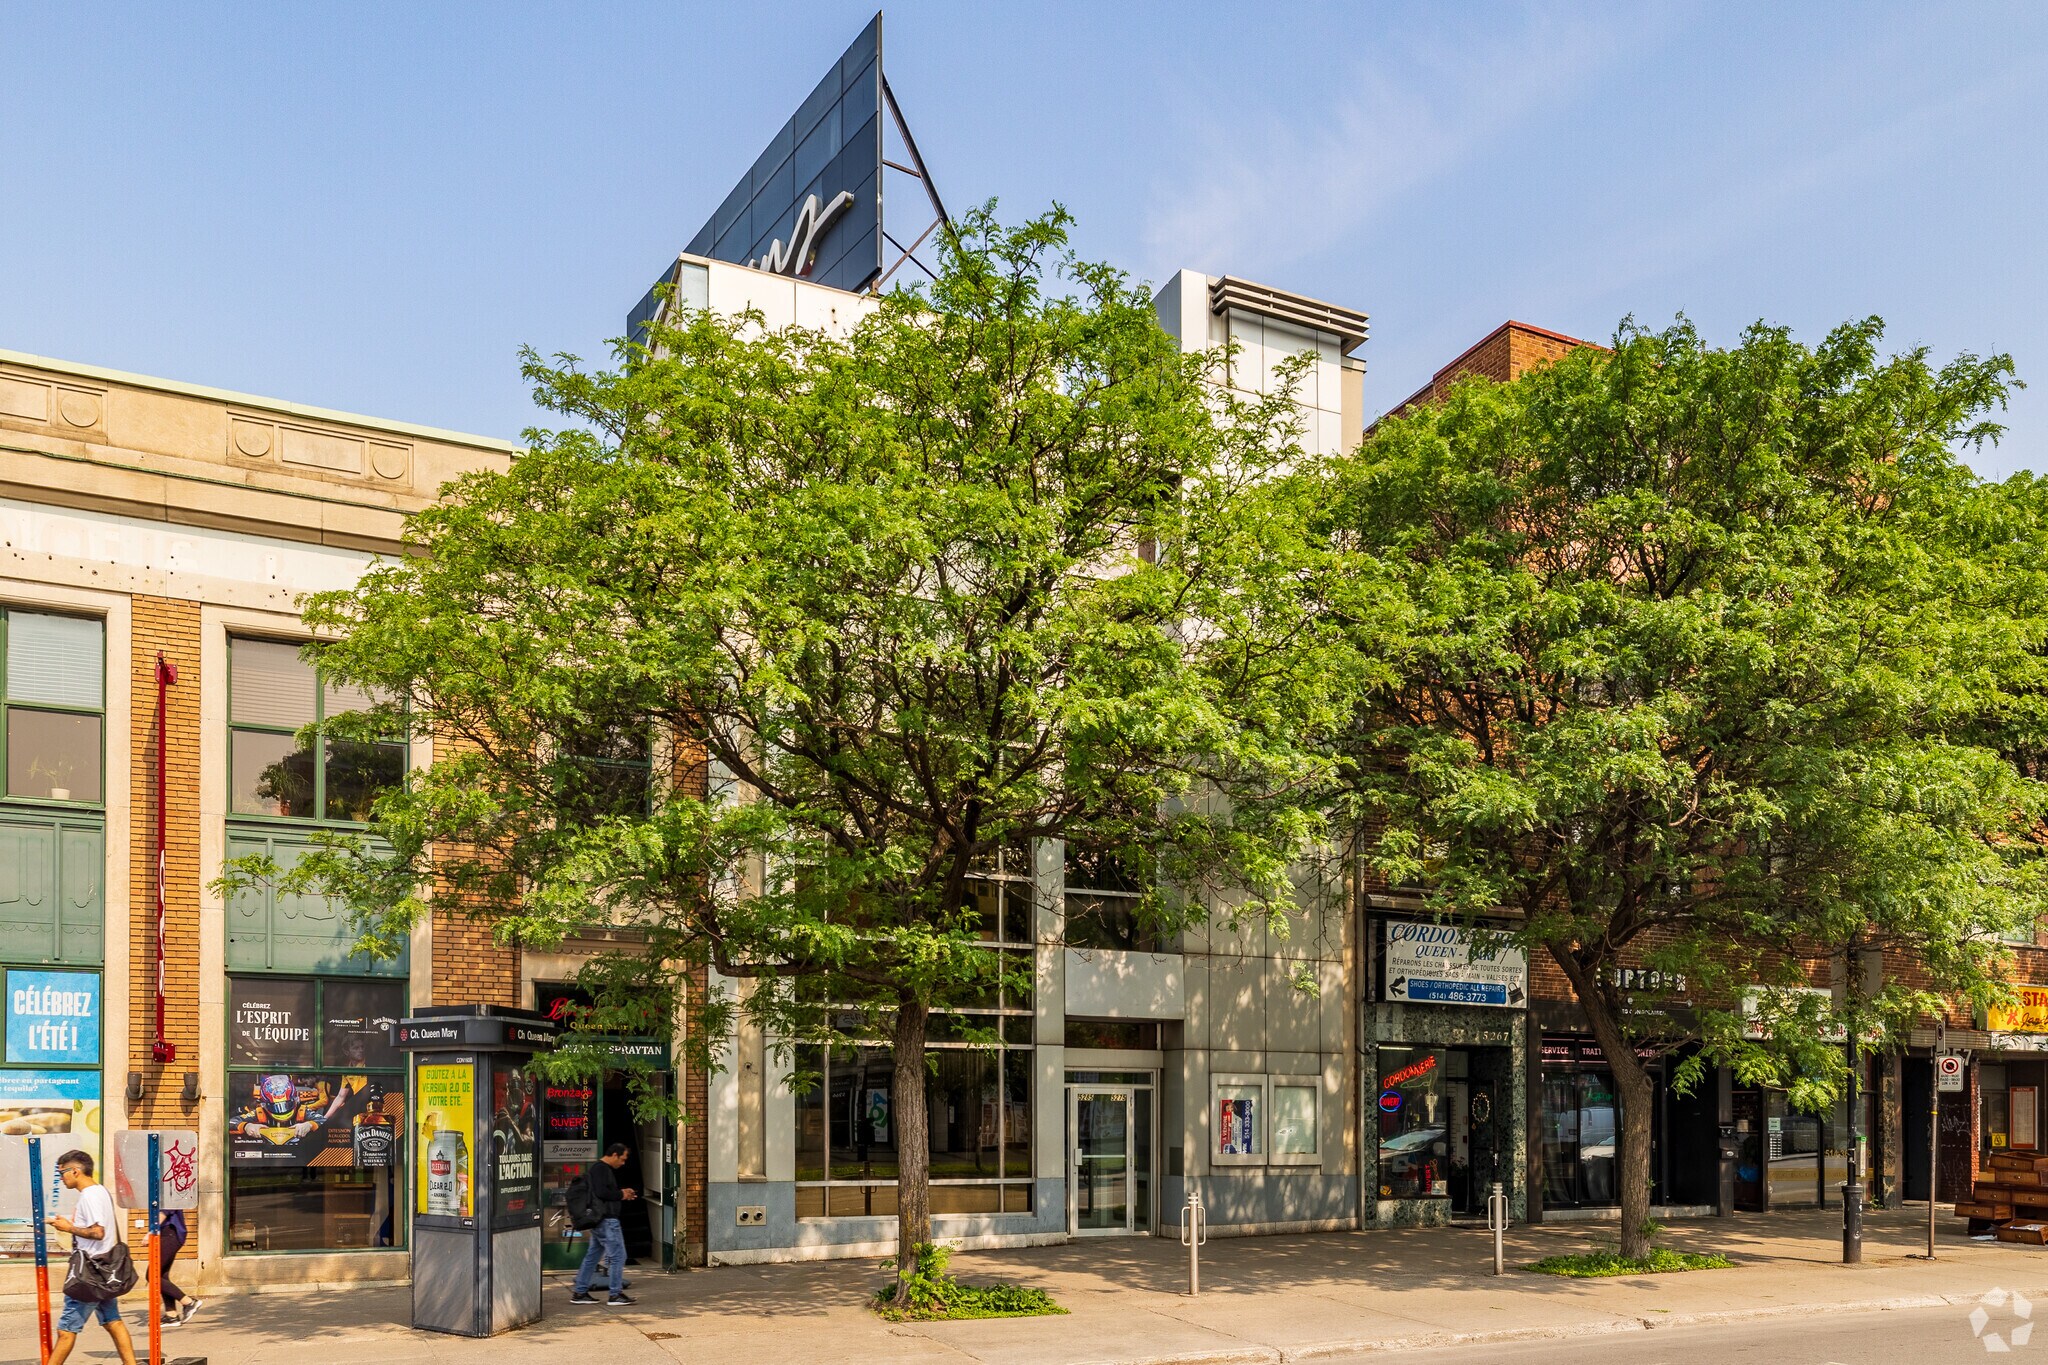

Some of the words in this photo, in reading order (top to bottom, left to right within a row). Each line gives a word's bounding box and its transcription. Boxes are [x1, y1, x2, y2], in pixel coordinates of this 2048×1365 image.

[1415, 944, 1458, 958] QUEEN
[1392, 957, 1422, 966] RÉPARONS
[1423, 959, 1433, 967] LES
[1480, 964, 1500, 973] TOUTES
[1501, 966, 1522, 974] SORTES
[1444, 970, 1459, 978] SACS
[1486, 973, 1508, 981] VALISES
[1410, 980, 1429, 989] SHOES
[1433, 982, 1469, 991] ORTHOPEDIC
[1481, 984, 1505, 993] REPAIRS
[14, 985, 92, 1017] CÉLÉBREZ
[1428, 992, 1447, 1000] (514)
[1448, 991, 1487, 1002] 486-3773
[242, 1001, 271, 1010] CÉLÉBREZ
[236, 1010, 291, 1024] L'ESPRIT
[28, 1019, 69, 1051] L'ÉTÉ
[254, 1024, 310, 1043] L'ÉQUIPE
[410, 1029, 420, 1039] Ch.
[420, 1028, 441, 1039] Queen
[441, 1027, 458, 1039] Mary
[527, 1032, 543, 1042] Queen
[543, 1033, 556, 1043] Mary
[1482, 1030, 1509, 1041] 5267
[608, 1045, 662, 1055] SPRAYTAN
[1541, 1046, 1569, 1055] SERVICE
[457, 1068, 467, 1080] LA
[1383, 1055, 1437, 1089] CORDONNERIE
[21, 1077, 33, 1085] en
[34, 1077, 80, 1086] partageant
[3, 1085, 39, 1093] tequila?
[422, 1082, 448, 1093] VERSION
[449, 1082, 460, 1093] 2.0
[462, 1082, 471, 1093] DE
[546, 1087, 593, 1099] Bronzage
[428, 1095, 448, 1106] VOTRE
[1380, 1096, 1401, 1107] OUVERT
[550, 1117, 586, 1127] OUVERT
[356, 1130, 371, 1142] JACK
[551, 1144, 592, 1154] Bronzage
[499, 1154, 521, 1164] TOUJOURS
[521, 1152, 533, 1162] DANS
[498, 1162, 533, 1181] L'ACTION
